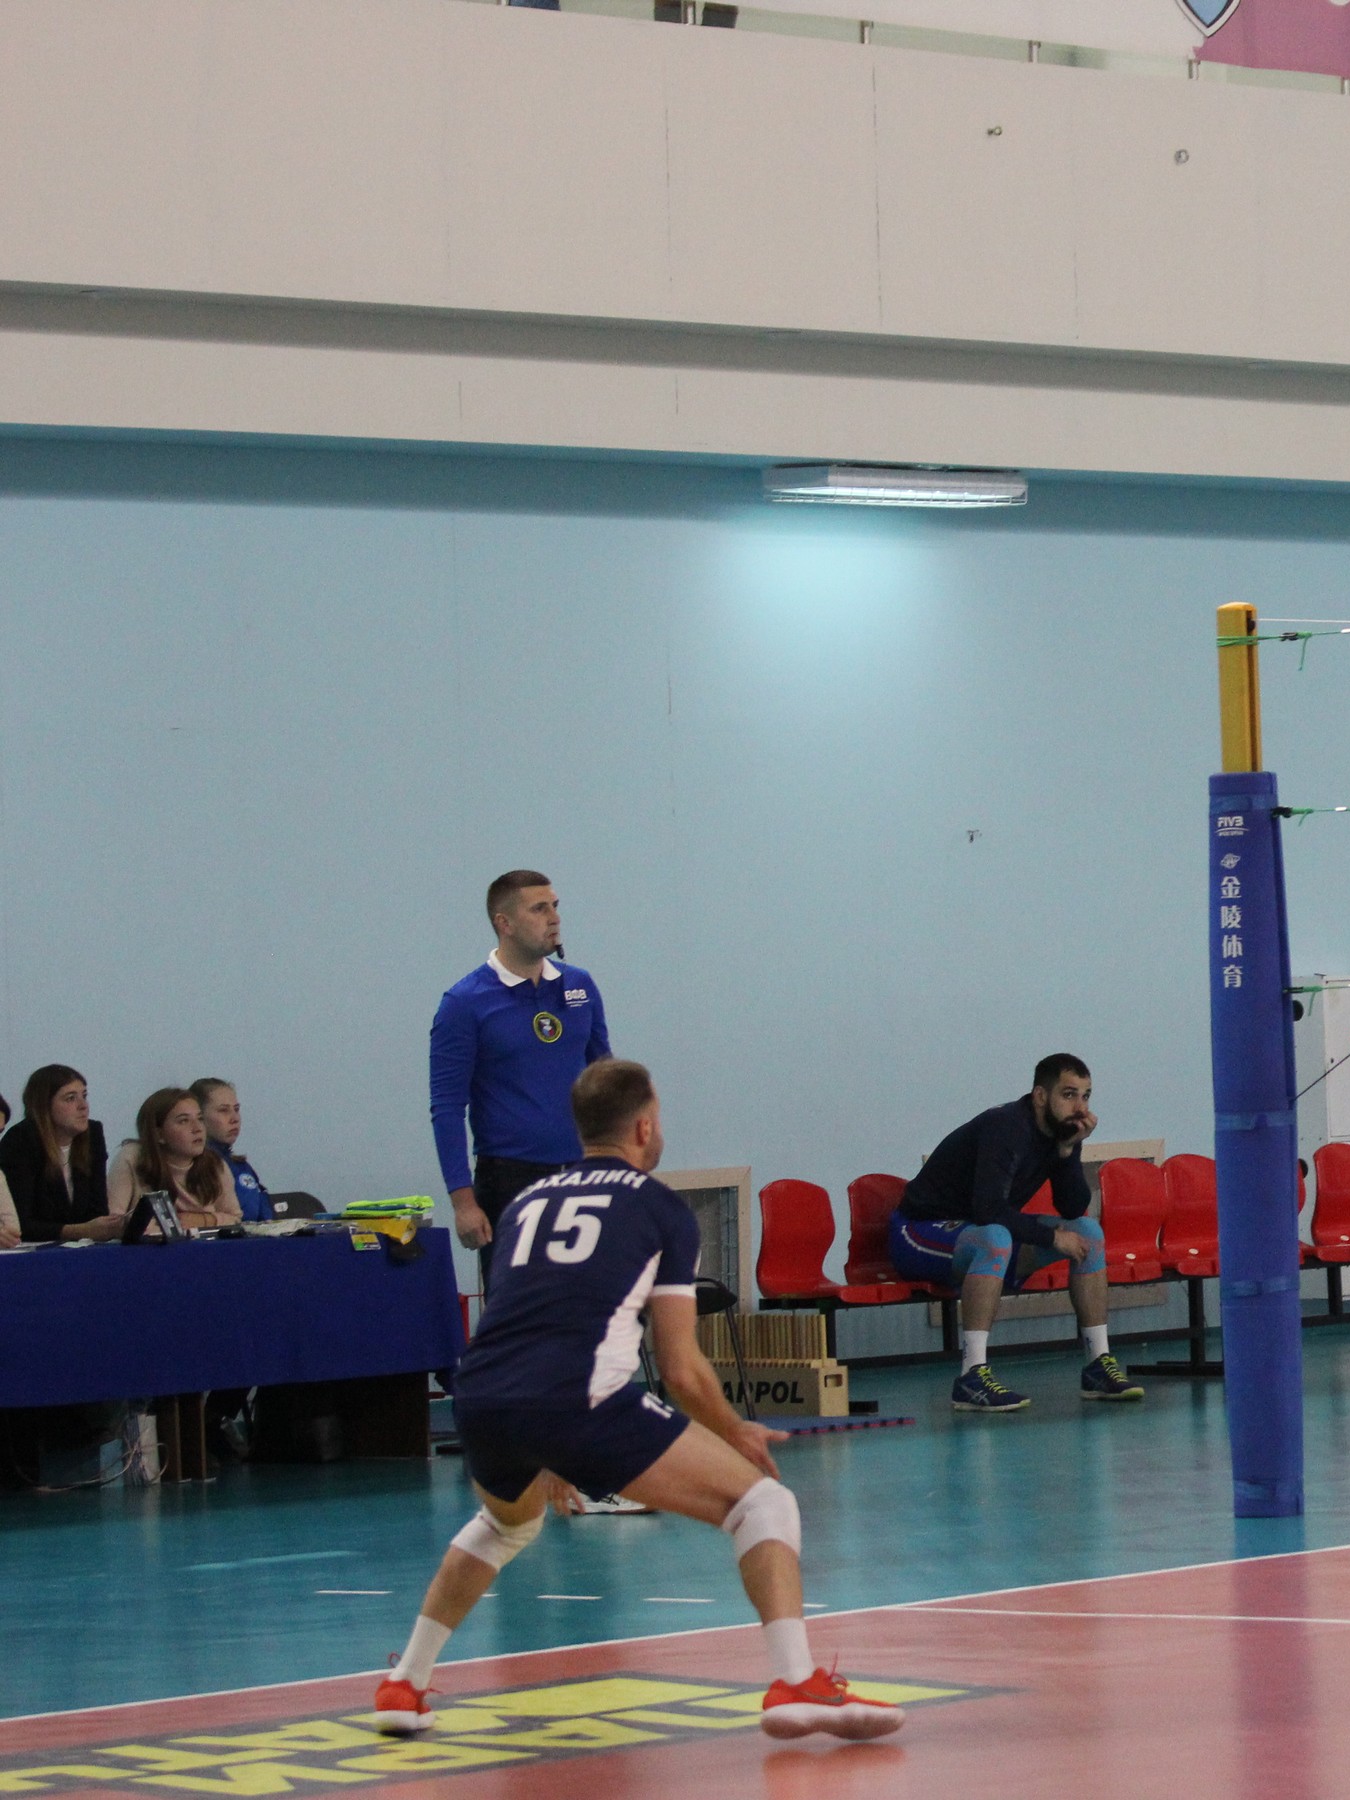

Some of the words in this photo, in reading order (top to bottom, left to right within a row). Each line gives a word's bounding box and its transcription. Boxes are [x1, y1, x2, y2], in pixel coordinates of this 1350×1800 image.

[1217, 815, 1244, 828] FIVB
[1220, 875, 1243, 988] 金陵体育
[510, 1194, 613, 1268] 15
